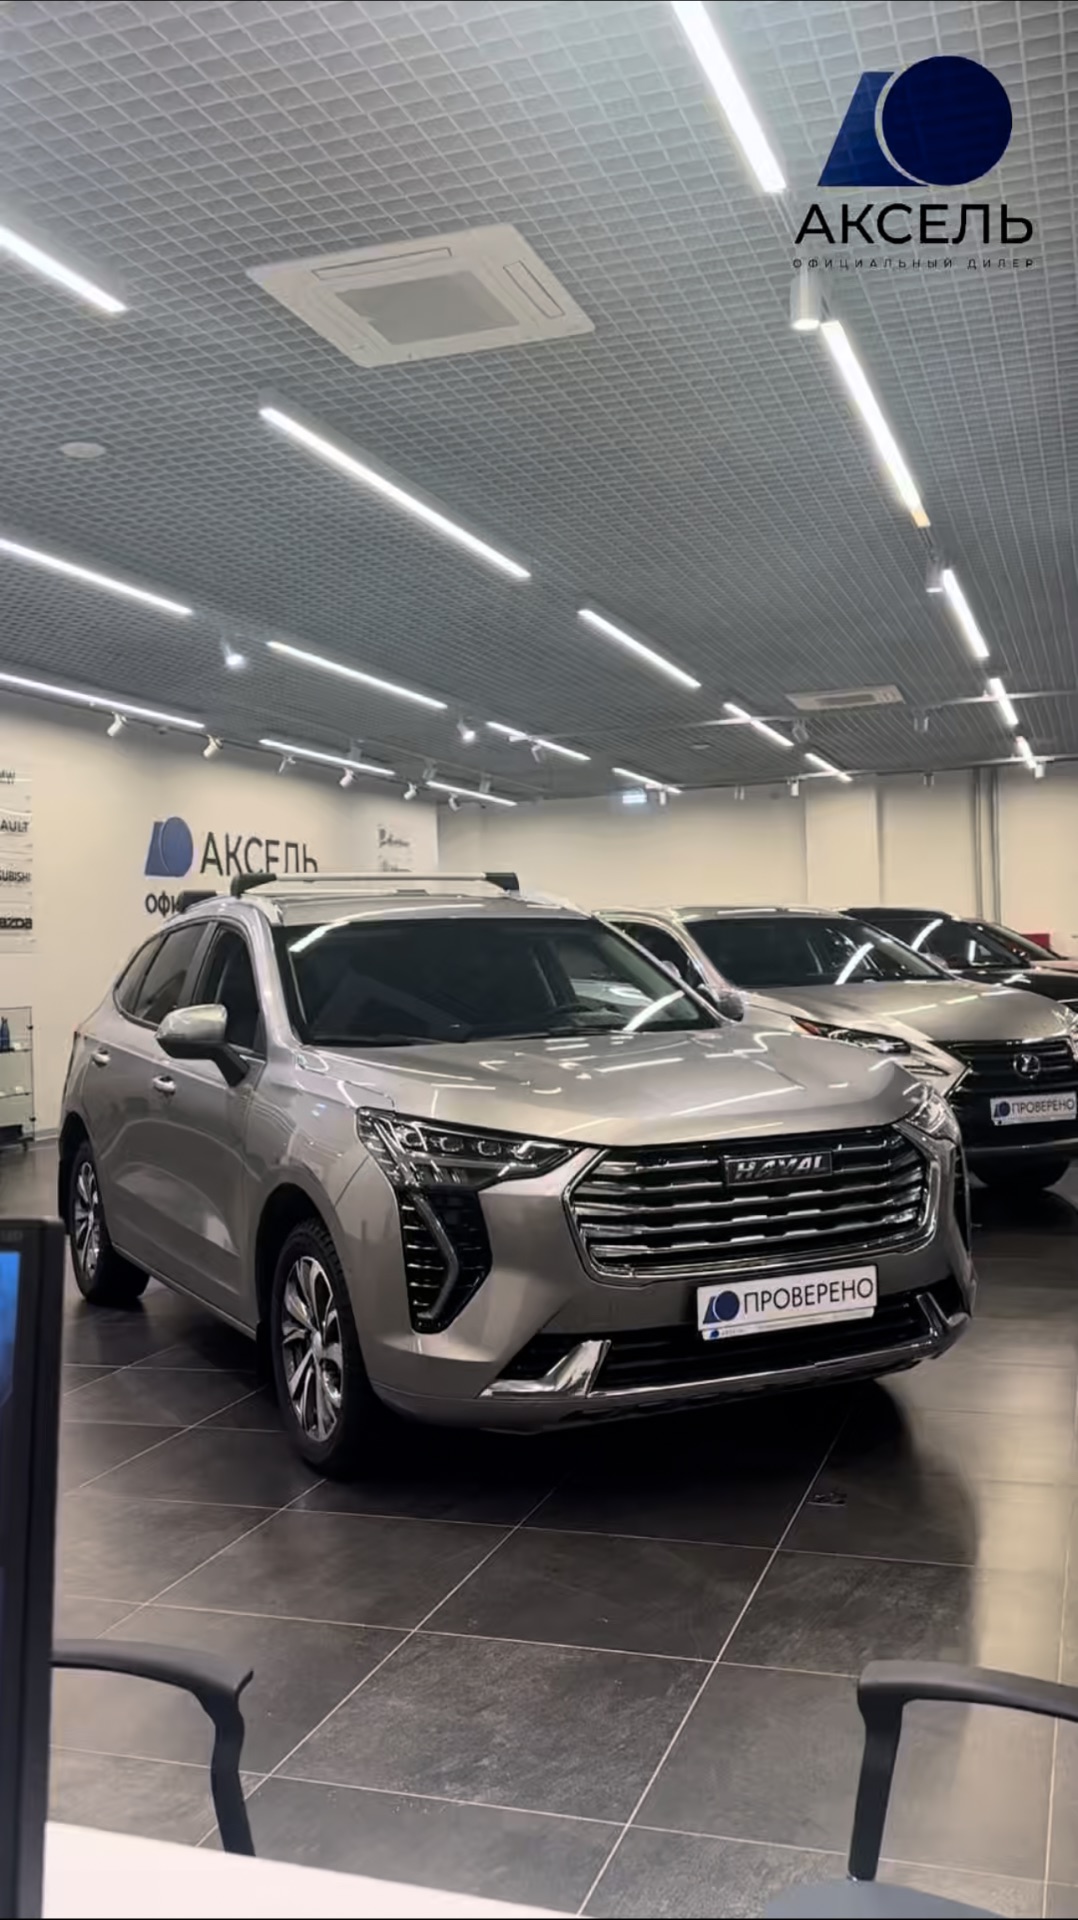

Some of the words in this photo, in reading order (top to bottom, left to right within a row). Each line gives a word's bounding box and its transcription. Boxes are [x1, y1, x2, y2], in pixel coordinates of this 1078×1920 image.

[1011, 1098, 1075, 1115] ПРОВЕРЕНО
[735, 1155, 829, 1180] HAVAL
[744, 1277, 874, 1315] ПРОВЕРЕНО
